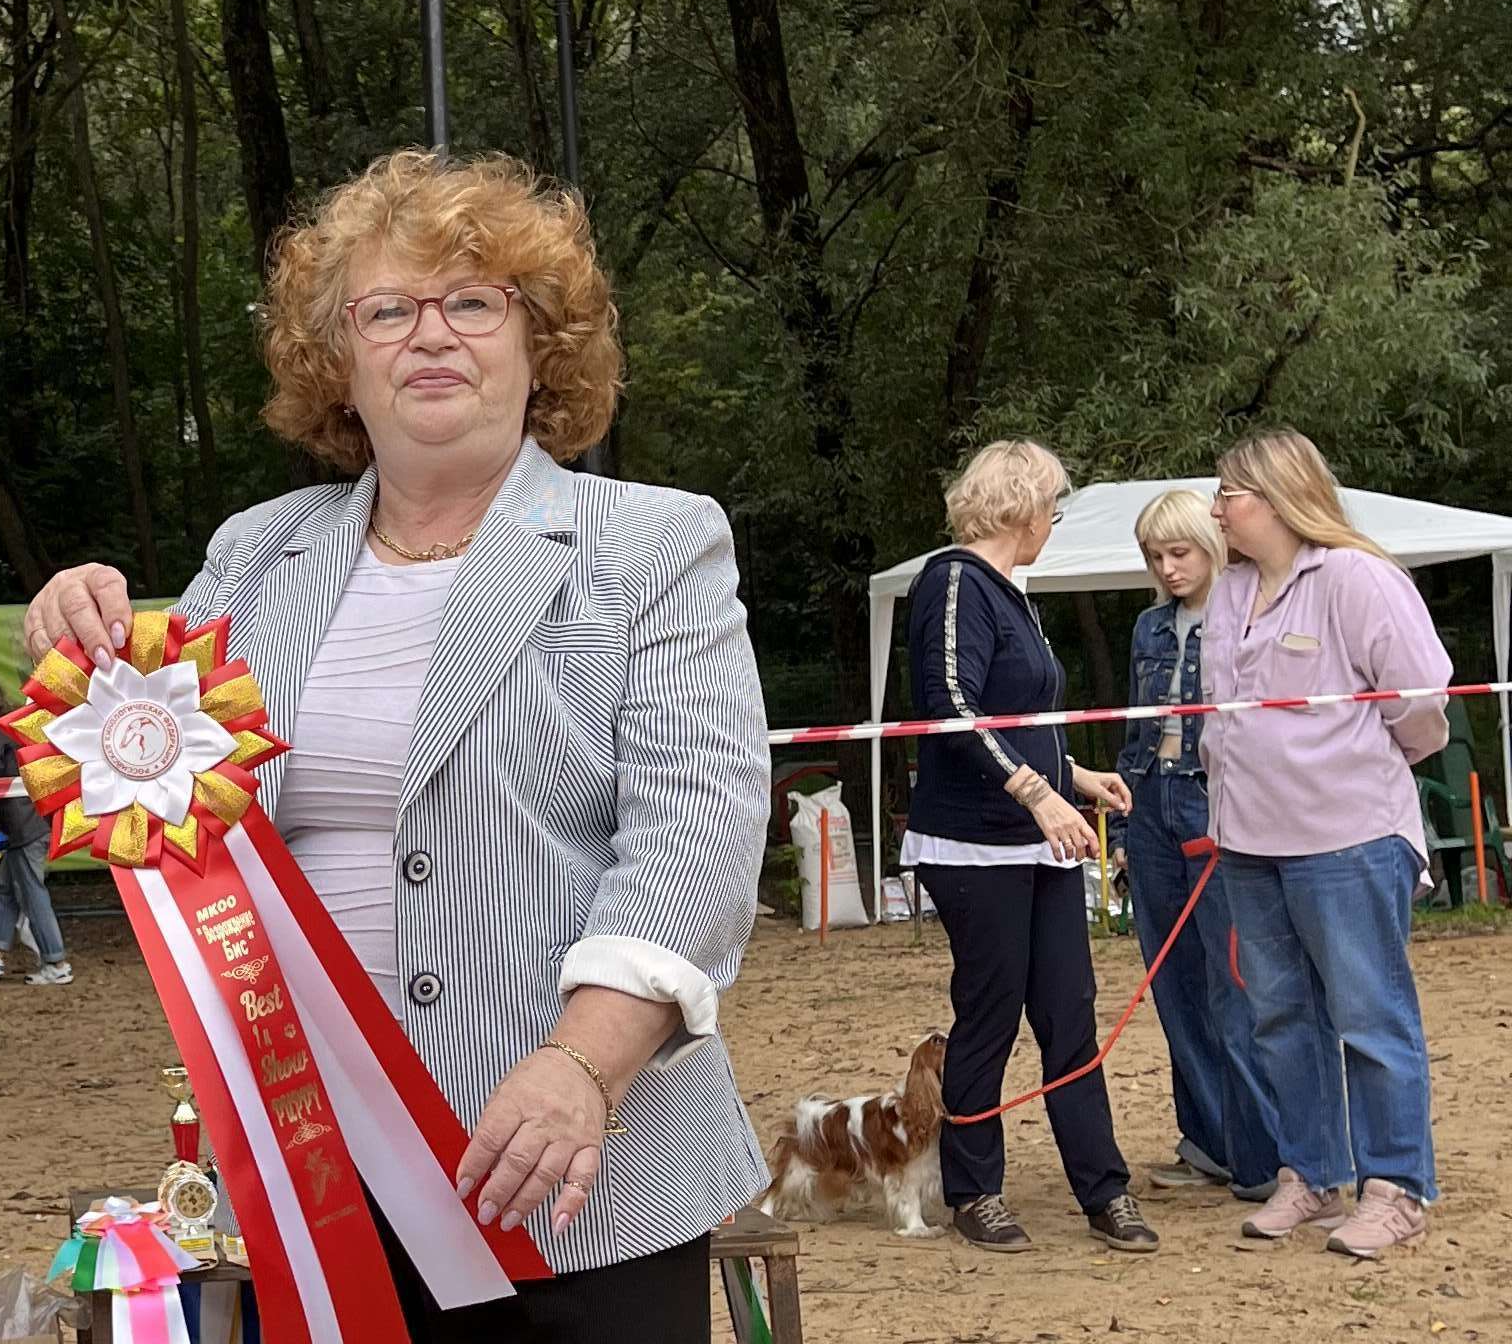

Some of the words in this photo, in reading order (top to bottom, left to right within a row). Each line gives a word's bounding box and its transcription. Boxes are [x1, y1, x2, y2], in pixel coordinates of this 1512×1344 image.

[195, 894, 238, 924] МКОО
[239, 983, 284, 1022] Best
[260, 1048, 309, 1086] Show
[271, 1083, 322, 1128] PUPPY
